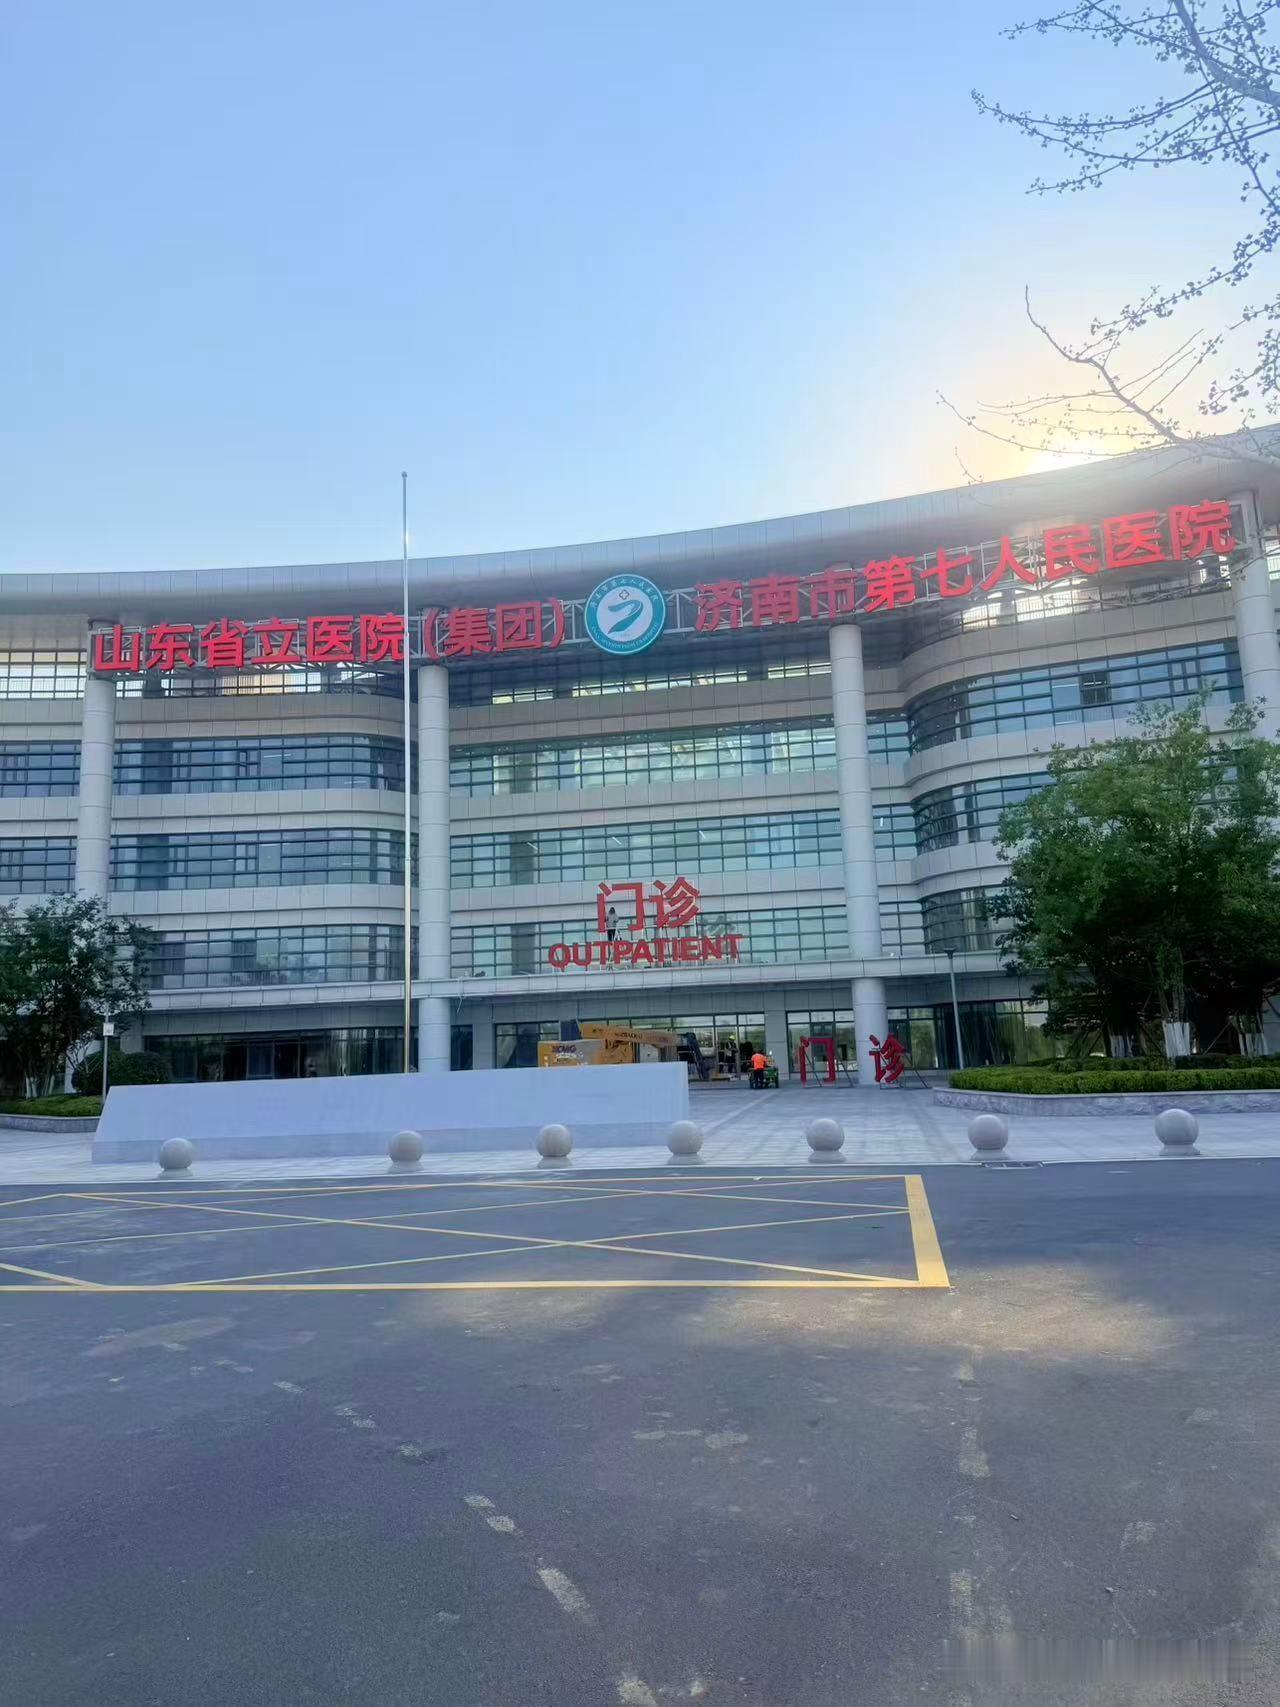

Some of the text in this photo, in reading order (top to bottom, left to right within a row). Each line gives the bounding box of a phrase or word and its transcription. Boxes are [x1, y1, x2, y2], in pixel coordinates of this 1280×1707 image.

[694, 499, 1236, 632] 济南市第七人民医院
[597, 876, 700, 933] 门诊
[548, 934, 743, 972] OUTPATIENT
[799, 1033, 905, 1084] 门诊
